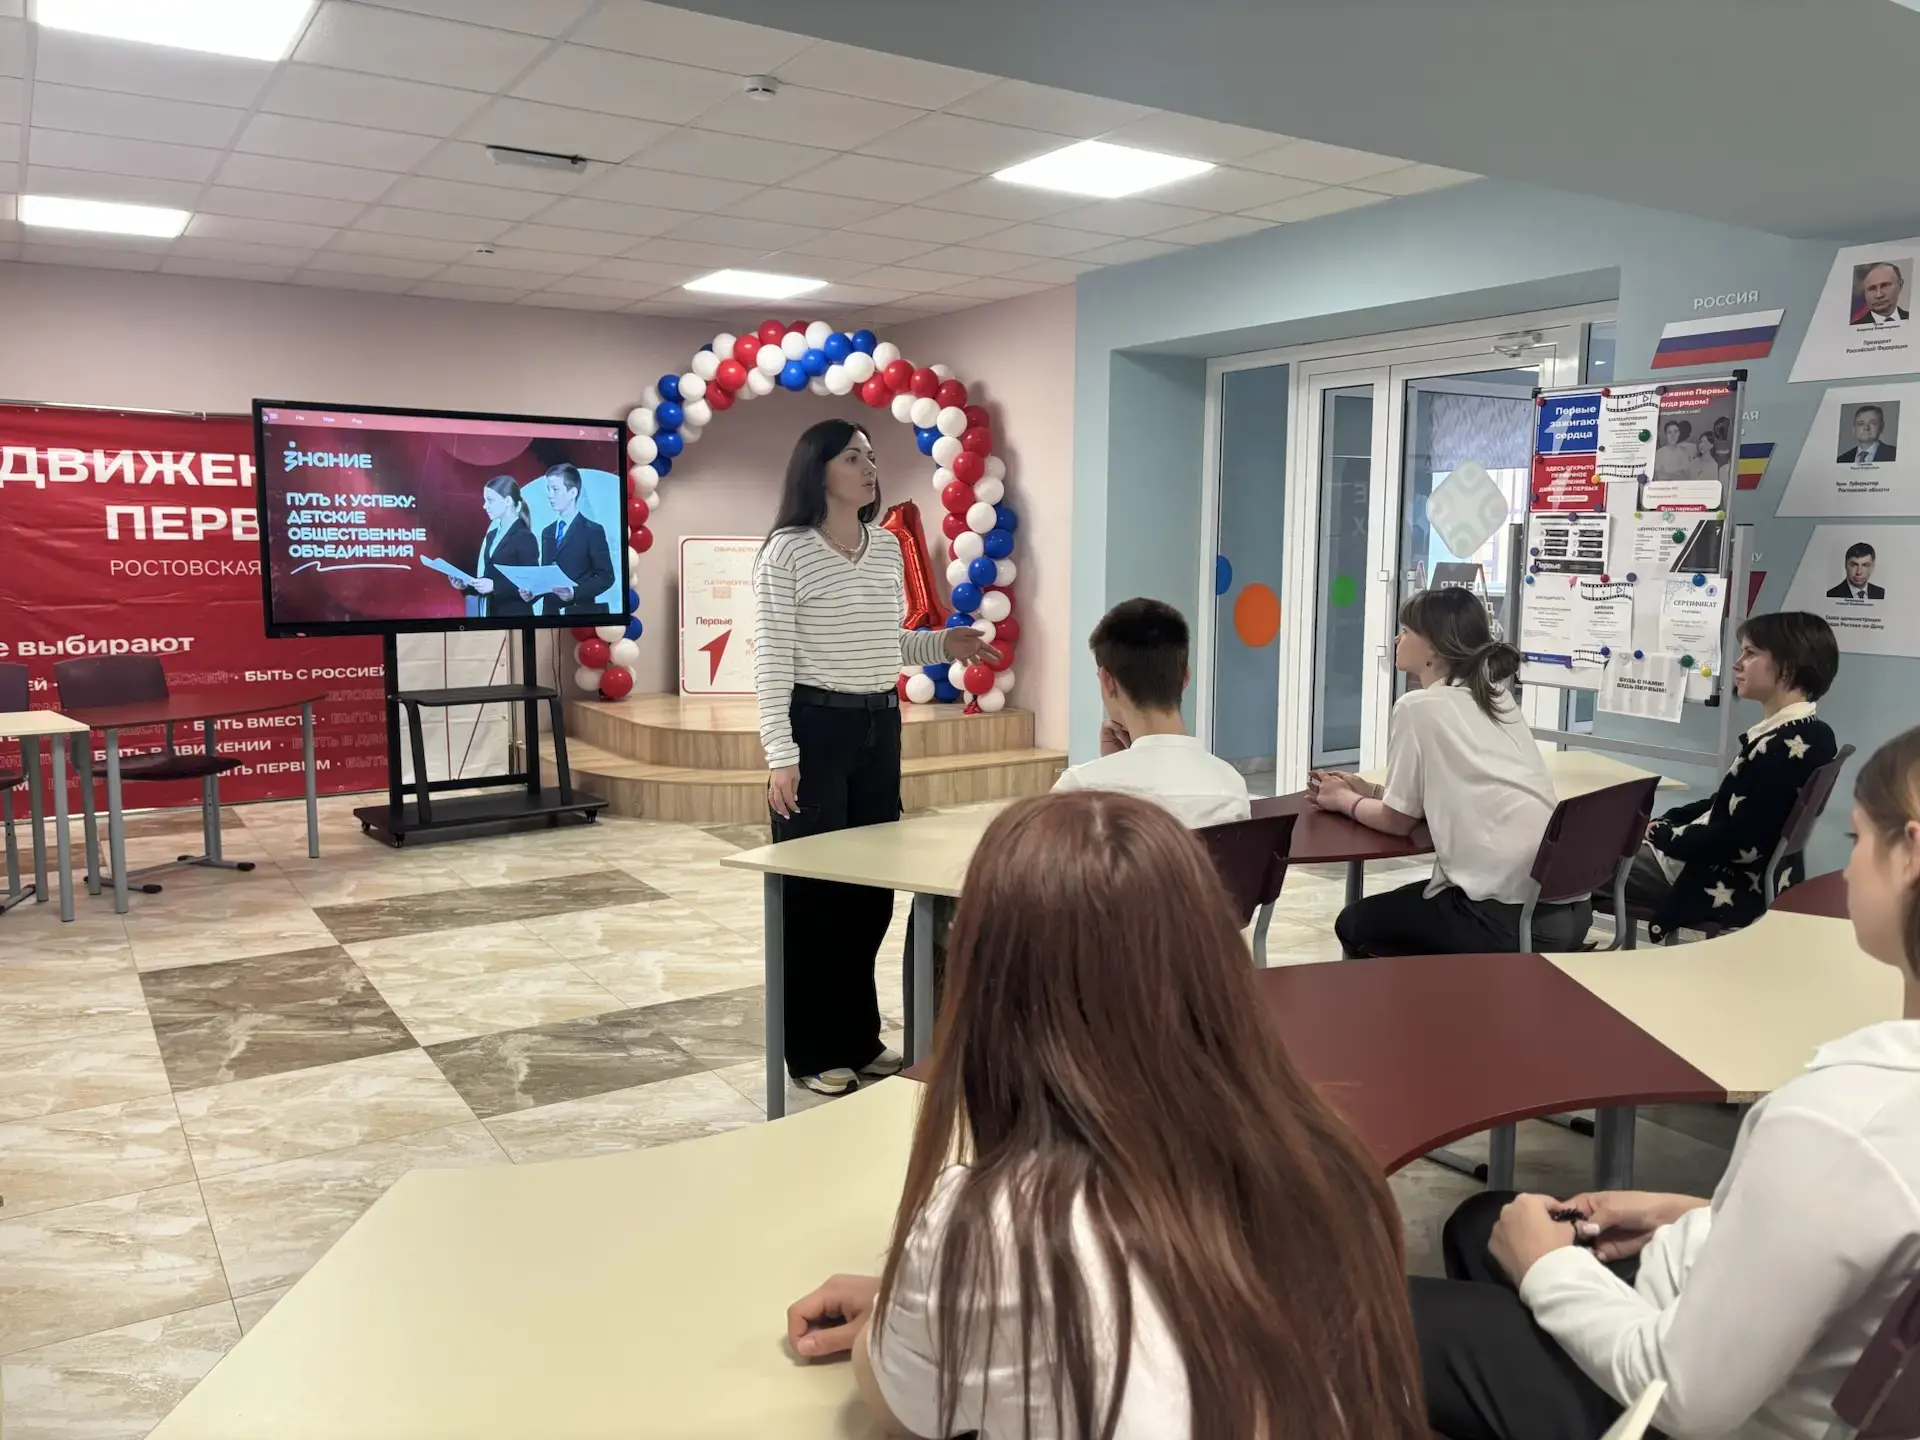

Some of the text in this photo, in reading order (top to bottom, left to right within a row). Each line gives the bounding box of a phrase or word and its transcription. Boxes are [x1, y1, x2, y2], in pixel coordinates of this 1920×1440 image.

[1693, 289, 1760, 310] РОССИЯ
[1663, 390, 1695, 398] ижение
[1679, 398, 1709, 407] рядом!
[1555, 406, 1597, 416] Первые
[1555, 431, 1593, 441] сердца
[285, 492, 417, 508] ПУТЬ К УСПЕХУ:
[286, 509, 367, 525] ДЕТСКИЕ
[287, 527, 428, 543] ОБЩЕСТВЕННЫЕ
[288, 544, 415, 560] ОБЪЕДИНЕНИЯ
[110, 559, 262, 577] РОСТОВСКАЯ
[1672, 599, 1719, 609] СЕРТИФИКАТ
[695, 616, 733, 628] Первые
[17, 632, 195, 657] выбирают
[244, 664, 386, 682] БЫТЬ С РОССИЕЙ
[1634, 685, 1668, 693] ПЕРВЫМ!
[93, 747, 147, 762] БТЬ
